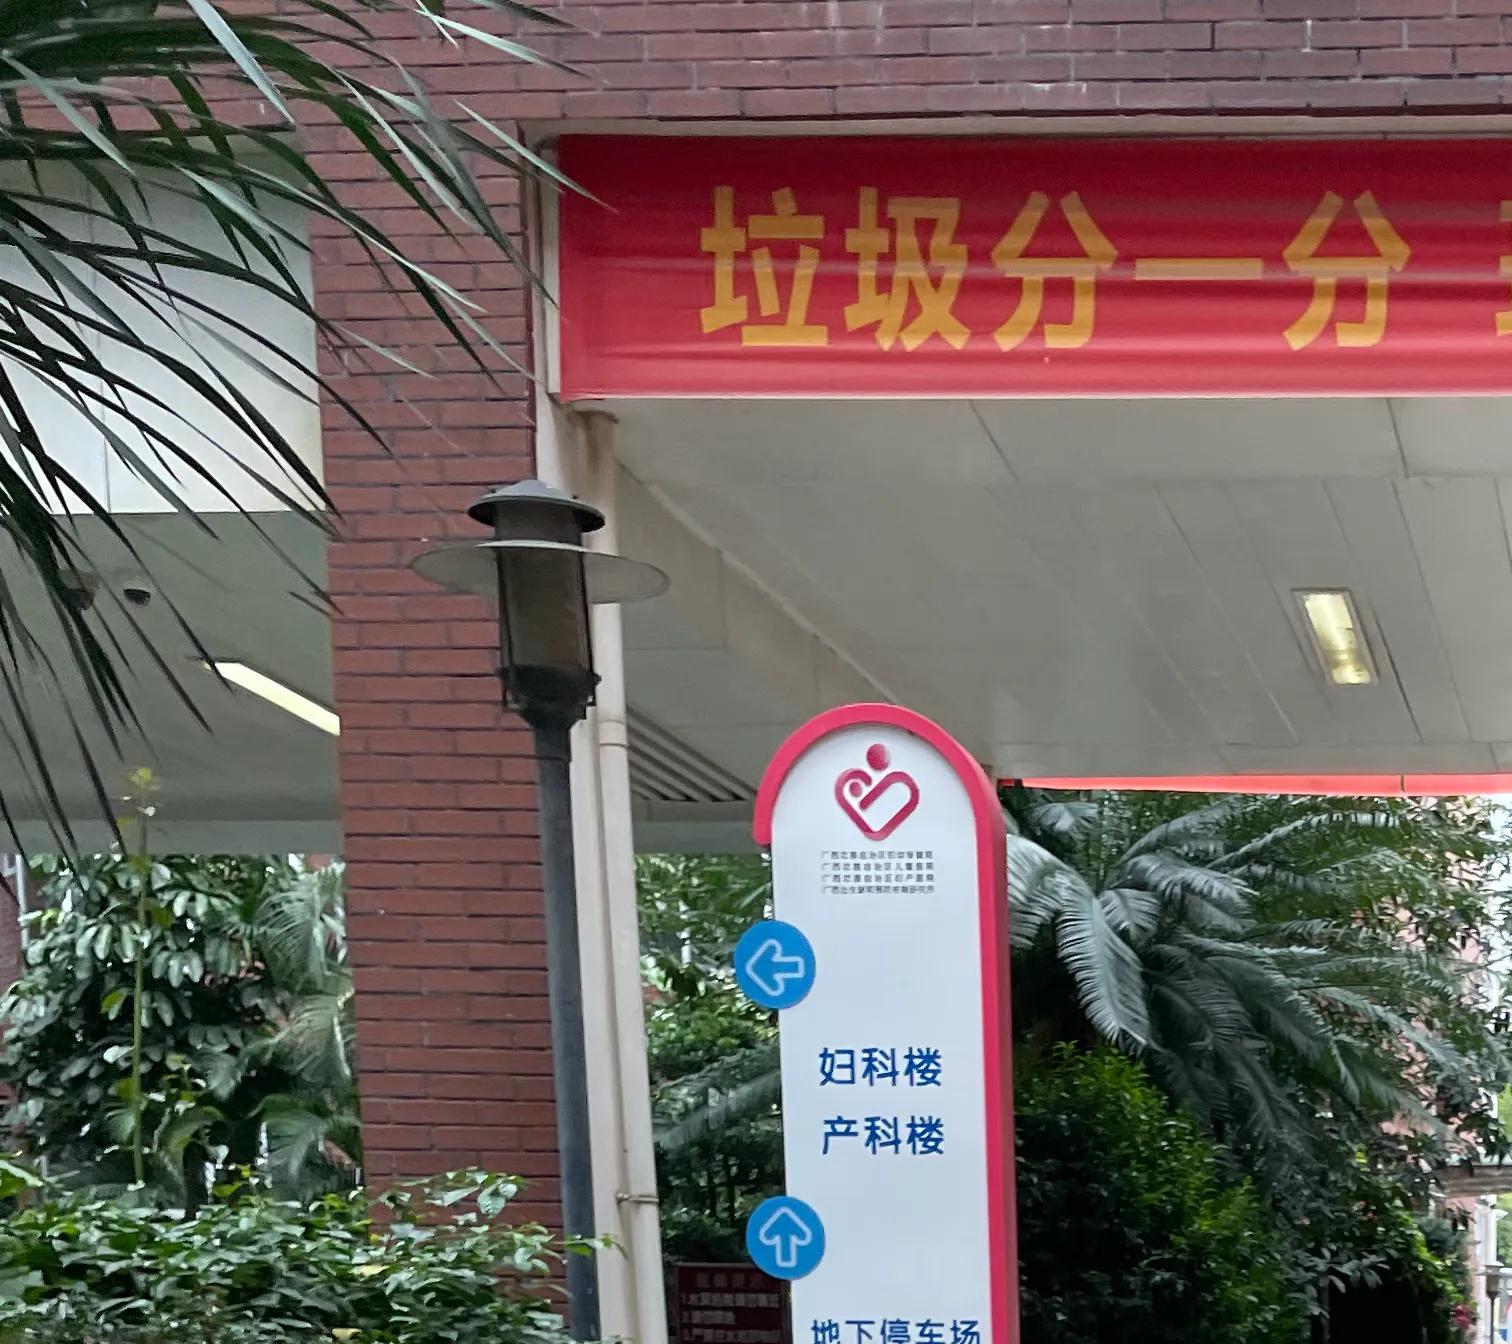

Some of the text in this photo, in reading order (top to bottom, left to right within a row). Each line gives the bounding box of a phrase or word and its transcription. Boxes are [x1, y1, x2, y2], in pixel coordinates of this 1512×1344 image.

[699, 185, 1412, 352] 垃圾分一分
[818, 1046, 943, 1088] 妇科楼
[822, 1114, 946, 1157] 产科楼
